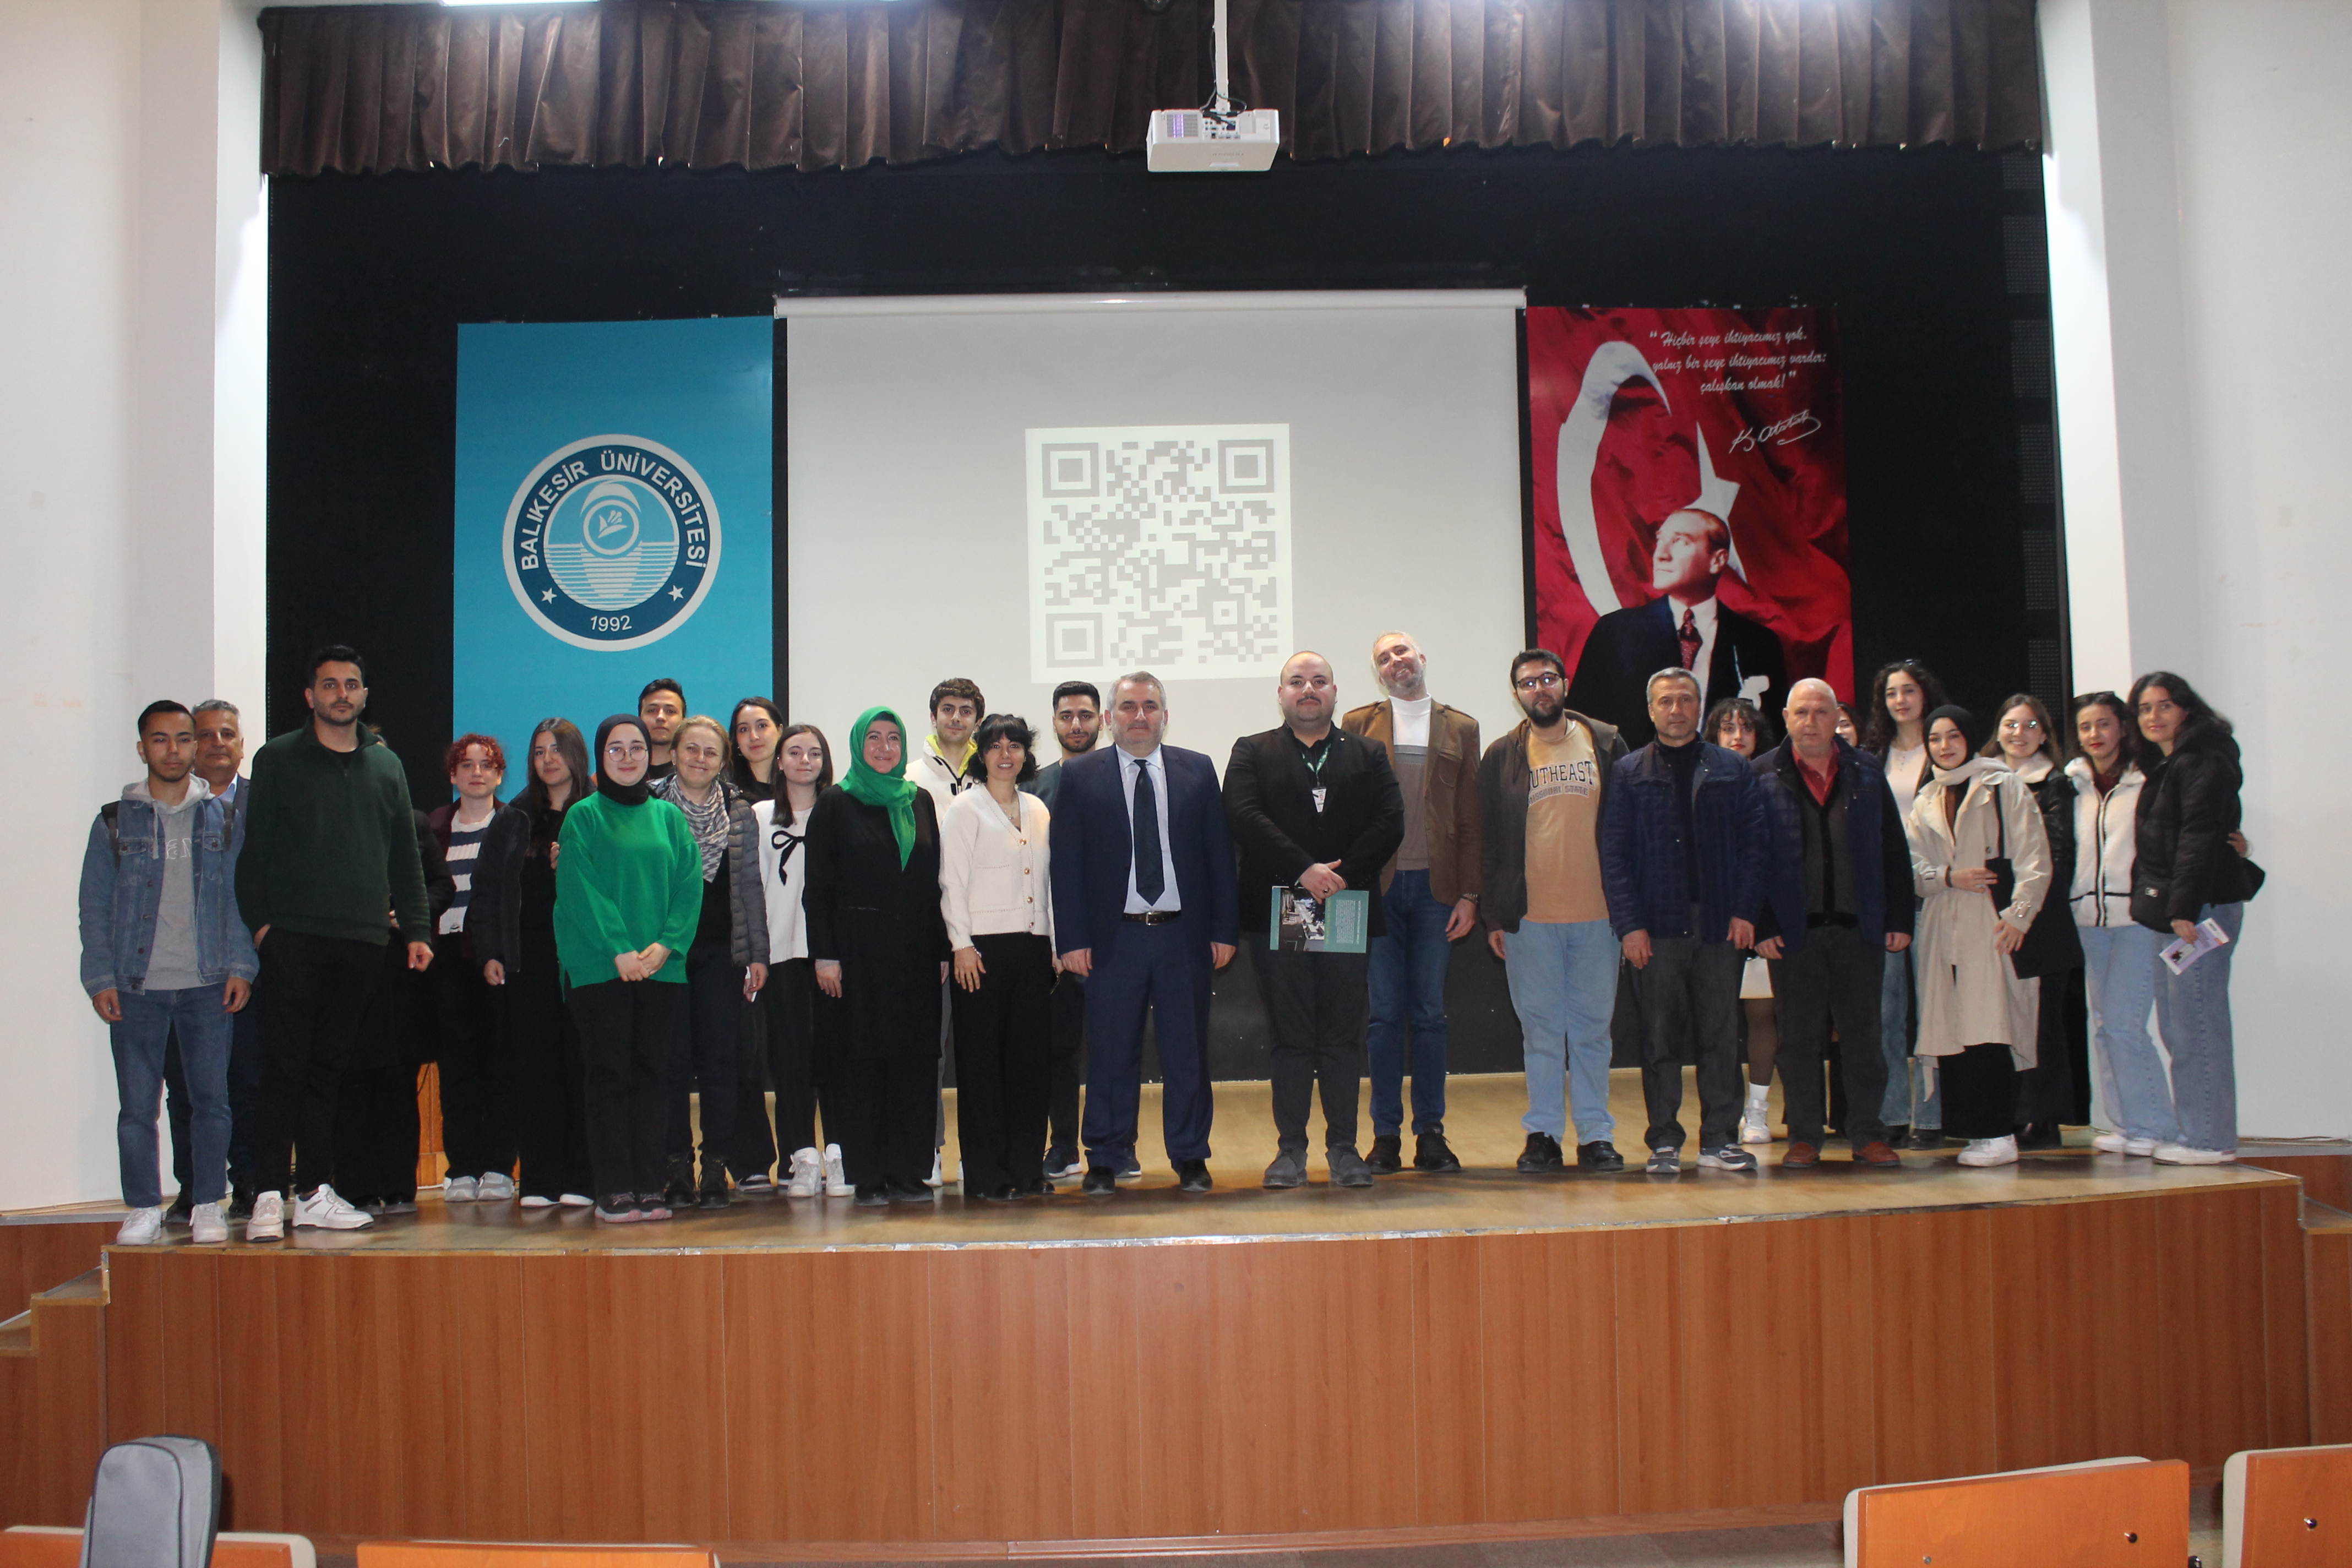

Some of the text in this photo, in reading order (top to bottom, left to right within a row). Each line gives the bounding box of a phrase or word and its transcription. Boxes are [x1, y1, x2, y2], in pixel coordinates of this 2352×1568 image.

[1698, 335, 1721, 348] şeye
[1724, 329, 1781, 346] ihtiyacımız
[1652, 358, 1683, 374] yalnız
[1685, 354, 1701, 369] bir
[1703, 358, 1726, 372] şeye
[1729, 352, 1786, 369] ihtiyacımız
[1700, 377, 1745, 395] çalışkan
[521, 450, 707, 570] BALIKESİR ÜNİVERSİTESİ
[590, 614, 633, 632] 1992
[1530, 761, 1593, 788] UTHEAST
[1564, 785, 1588, 796] STATE
